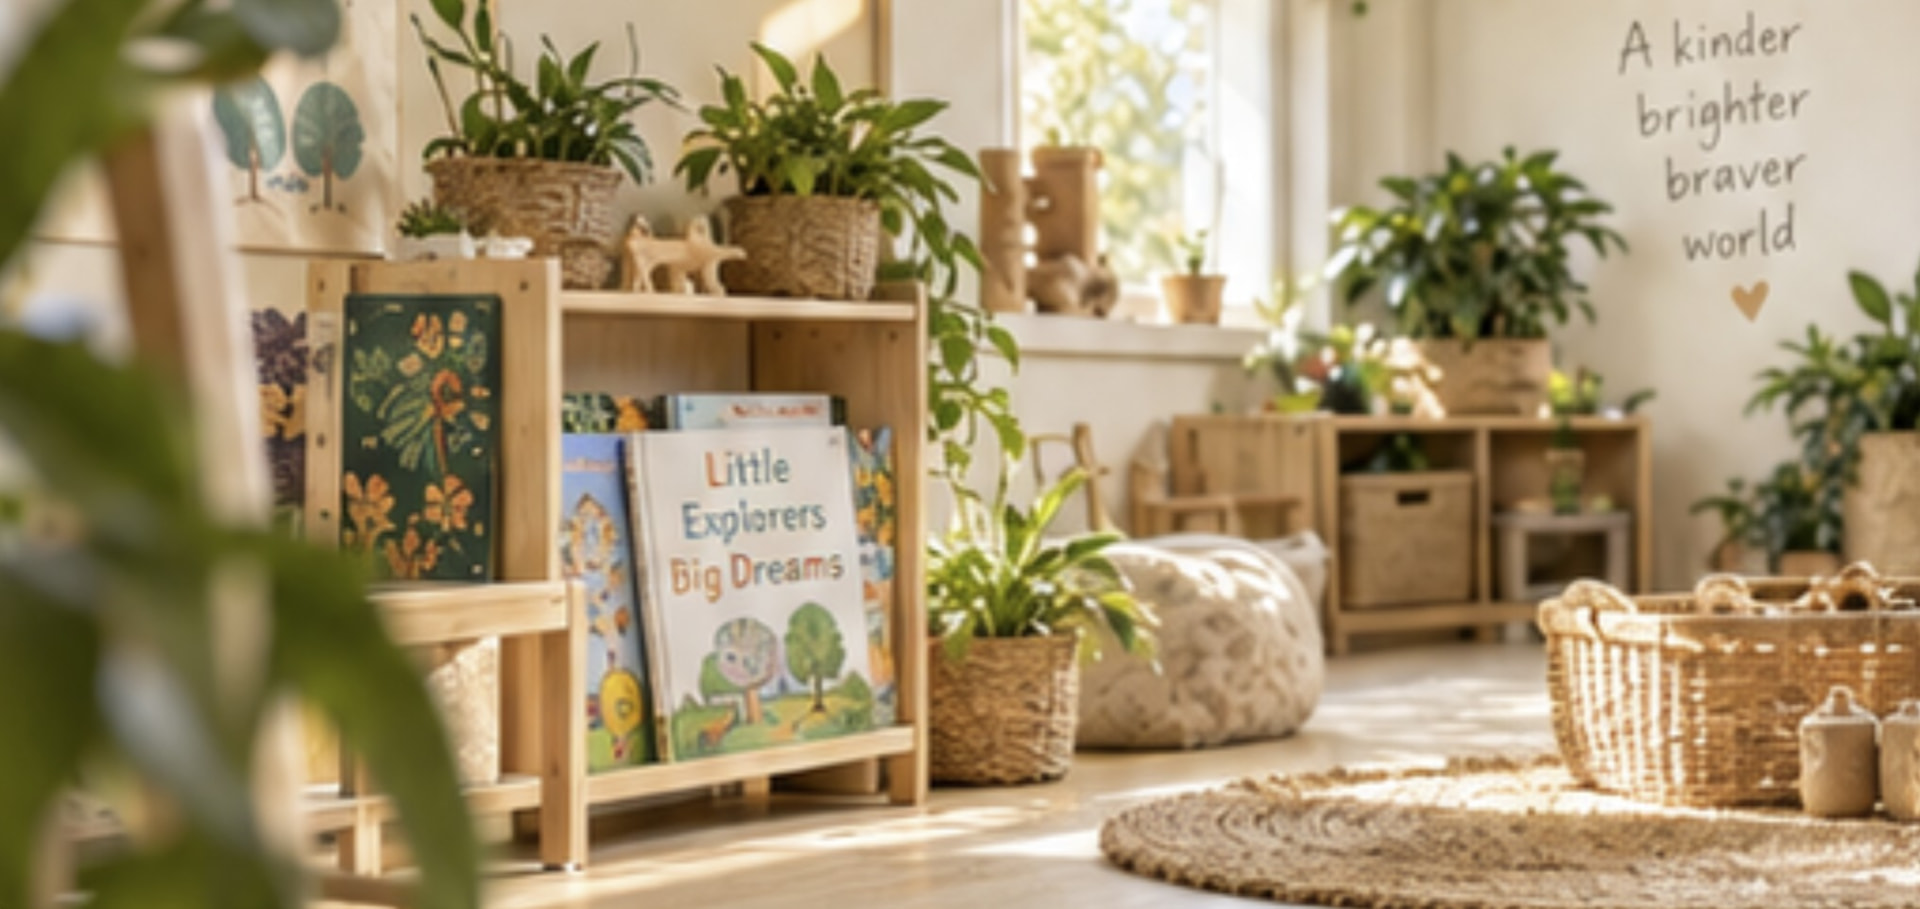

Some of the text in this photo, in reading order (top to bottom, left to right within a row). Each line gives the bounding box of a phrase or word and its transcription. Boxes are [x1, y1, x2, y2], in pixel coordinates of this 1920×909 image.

[1618, 10, 1802, 76] A kinder
[1636, 79, 1811, 152] brighter
[1665, 153, 1807, 202] braver
[1682, 202, 1797, 261] world
[704, 447, 790, 489] Little
[681, 499, 827, 545] Explorers
[669, 552, 845, 602] Big Dreams
